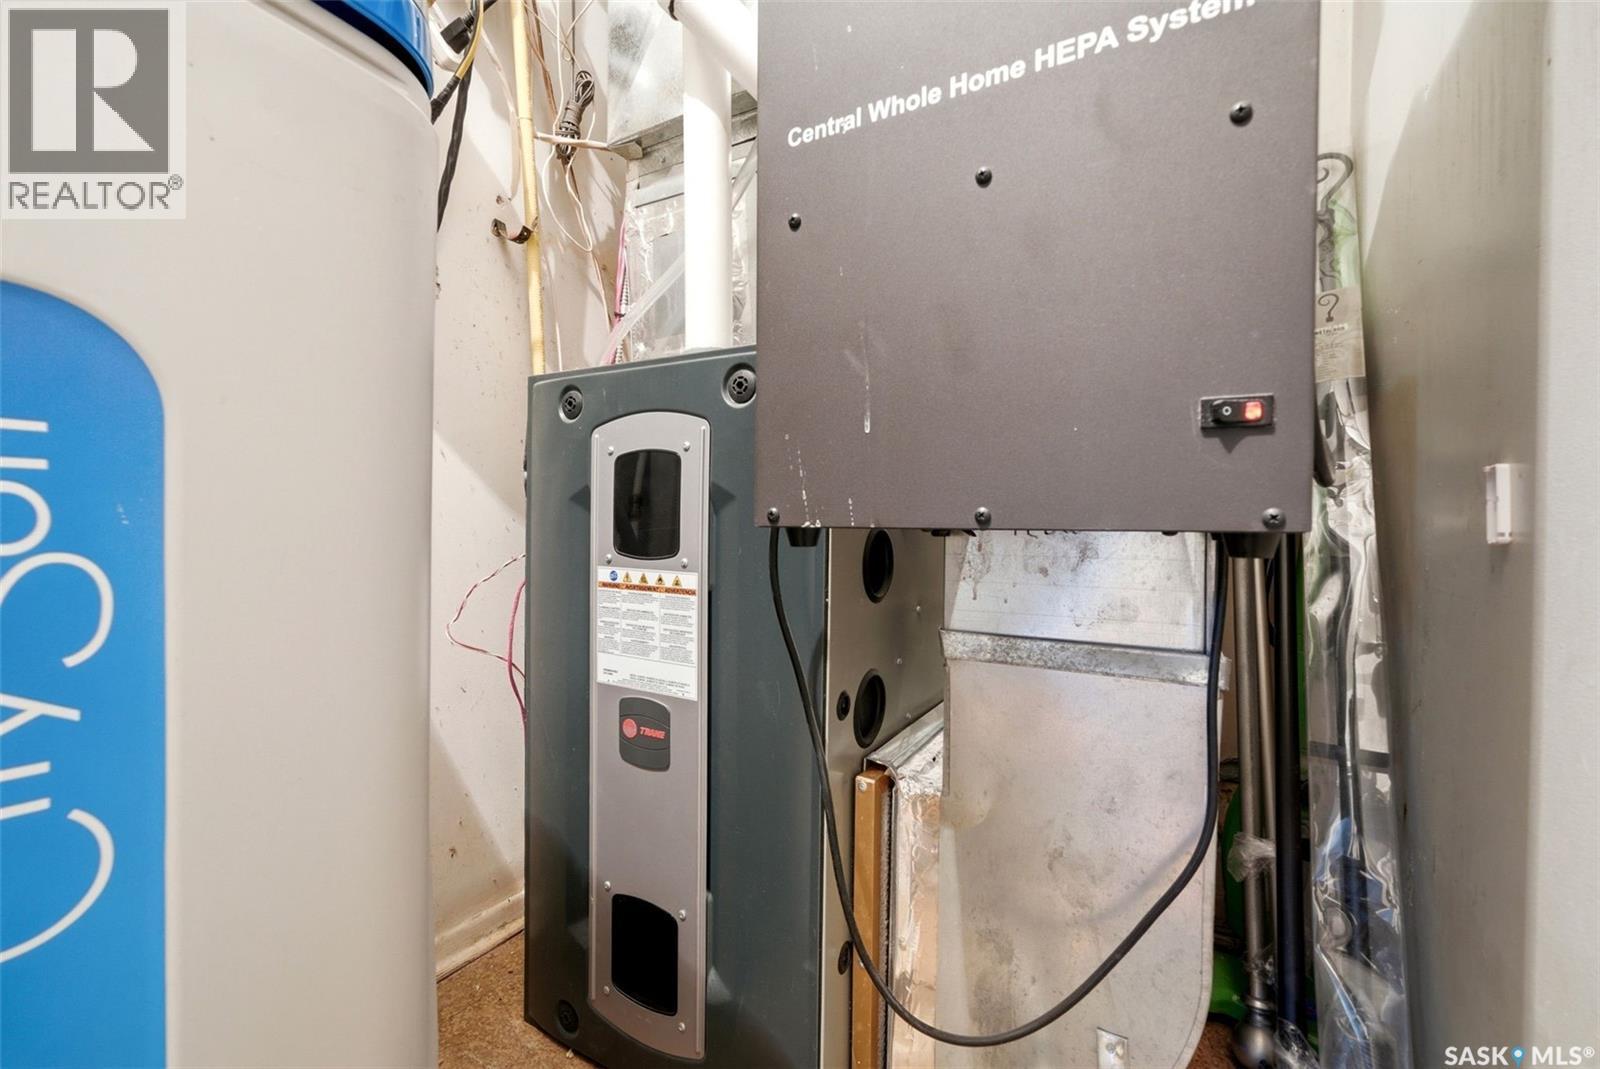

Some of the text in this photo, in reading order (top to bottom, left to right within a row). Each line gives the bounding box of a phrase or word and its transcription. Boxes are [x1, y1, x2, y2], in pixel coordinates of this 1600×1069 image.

[787, 107, 862, 147] Central
[868, 85, 942, 122] Whole
[949, 59, 1026, 98] Home
[1034, 25, 1119, 72] HEPA
